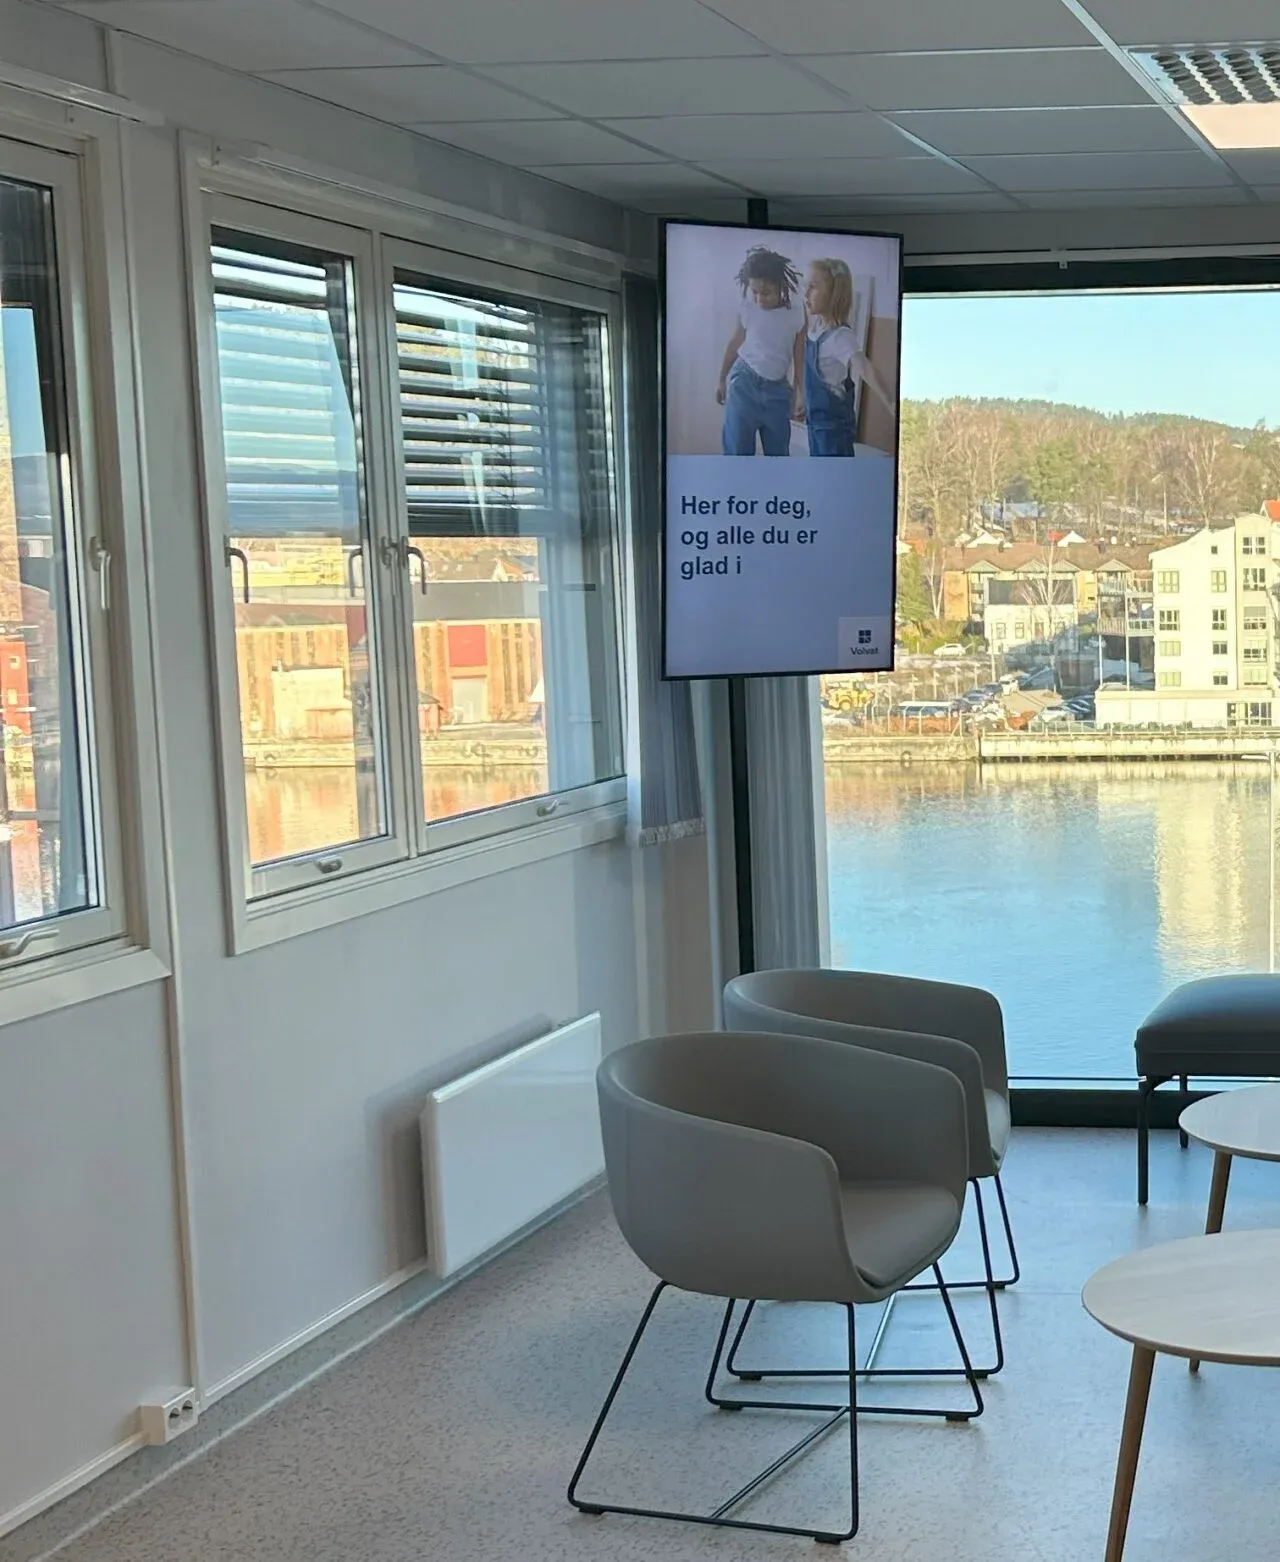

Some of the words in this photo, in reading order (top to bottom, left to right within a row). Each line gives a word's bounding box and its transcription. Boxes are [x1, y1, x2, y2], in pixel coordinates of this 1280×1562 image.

[681, 495, 720, 515] Her
[727, 496, 758, 515] for
[765, 496, 811, 519] deg,
[681, 530, 709, 549] og
[717, 526, 755, 544] alle
[762, 526, 789, 544] du
[797, 529, 818, 544] er
[681, 556, 728, 580] glad
[736, 556, 741, 574] i
[851, 647, 879, 655] Volvat
